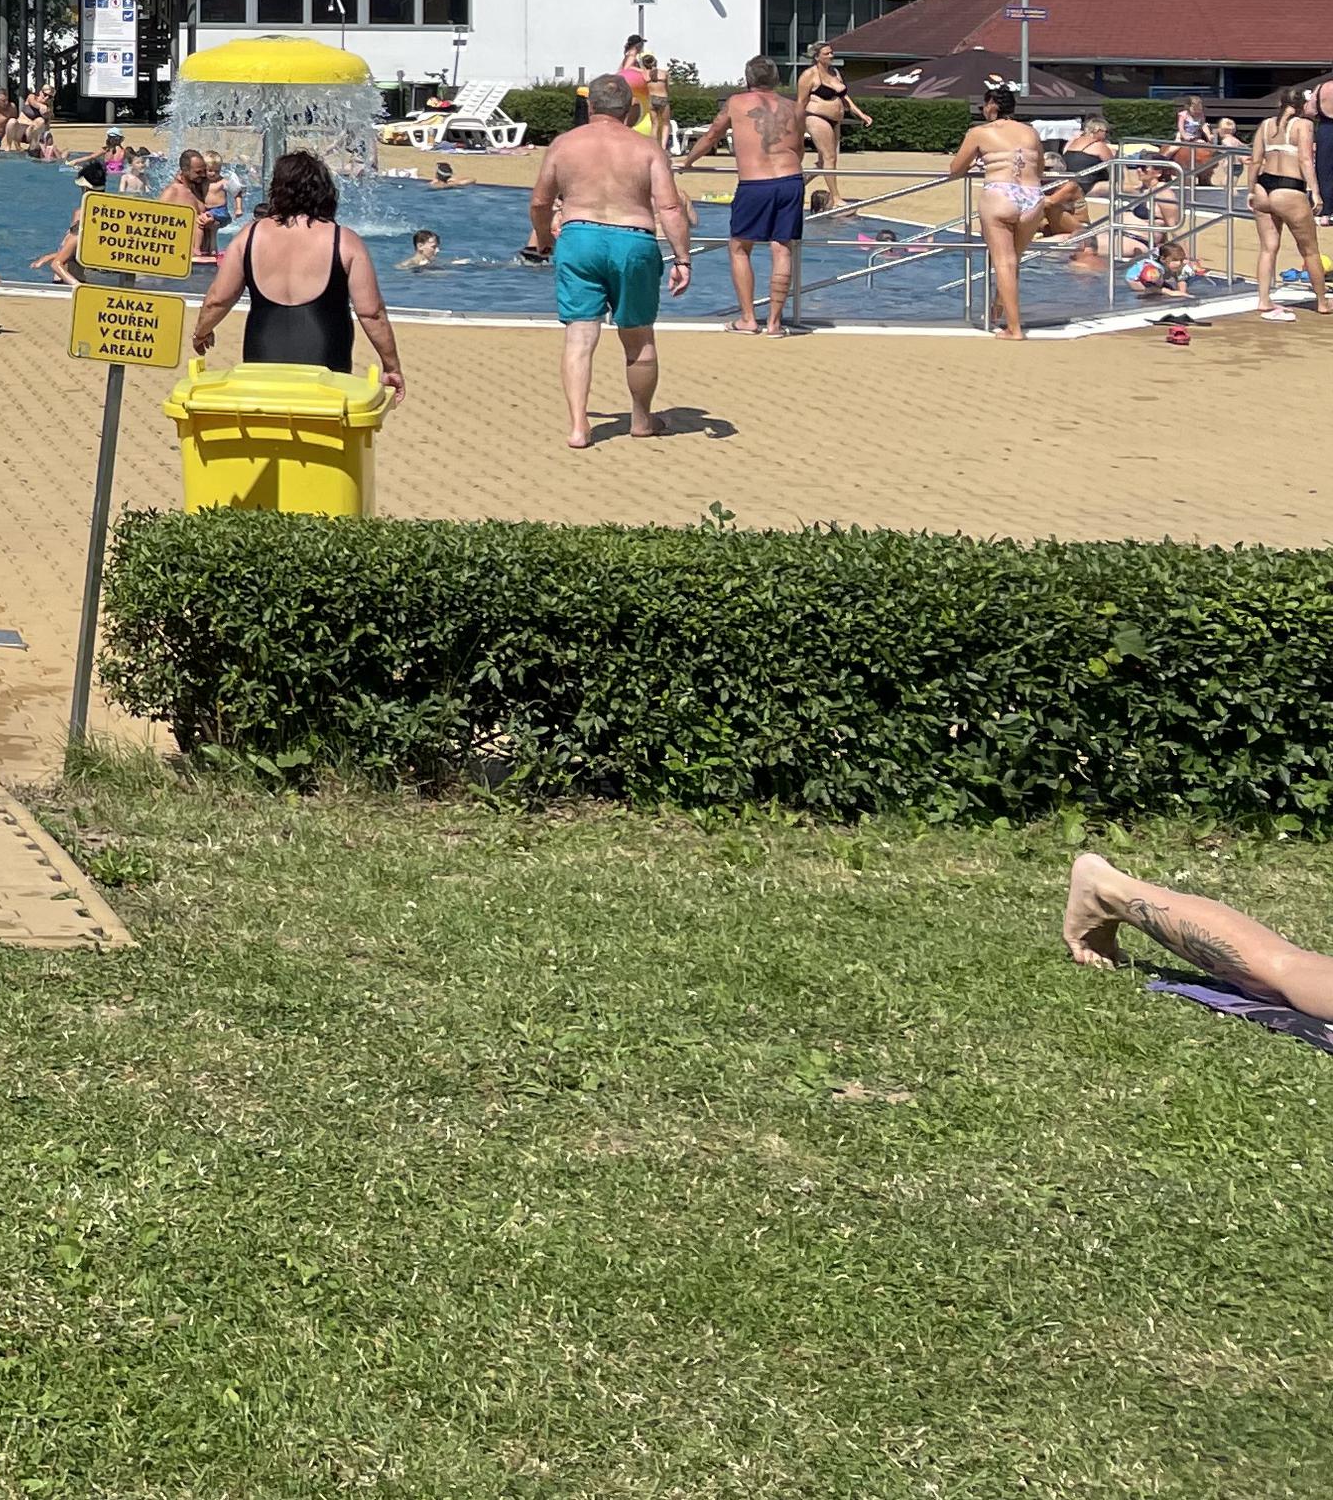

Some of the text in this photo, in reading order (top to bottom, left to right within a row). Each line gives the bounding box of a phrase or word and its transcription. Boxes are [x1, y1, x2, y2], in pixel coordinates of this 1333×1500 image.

[92, 205, 187, 228] PŘED VSTUPEM
[100, 221, 176, 240] DO BAZÉNU
[98, 235, 175, 255] POUŽÍVEJTE
[110, 252, 161, 266] SPRCHU
[106, 297, 154, 313] ZÁKAZ
[98, 311, 159, 329] KOUŘENÍ
[100, 327, 155, 343] V CELÉM
[99, 342, 153, 359] AREÁLU
